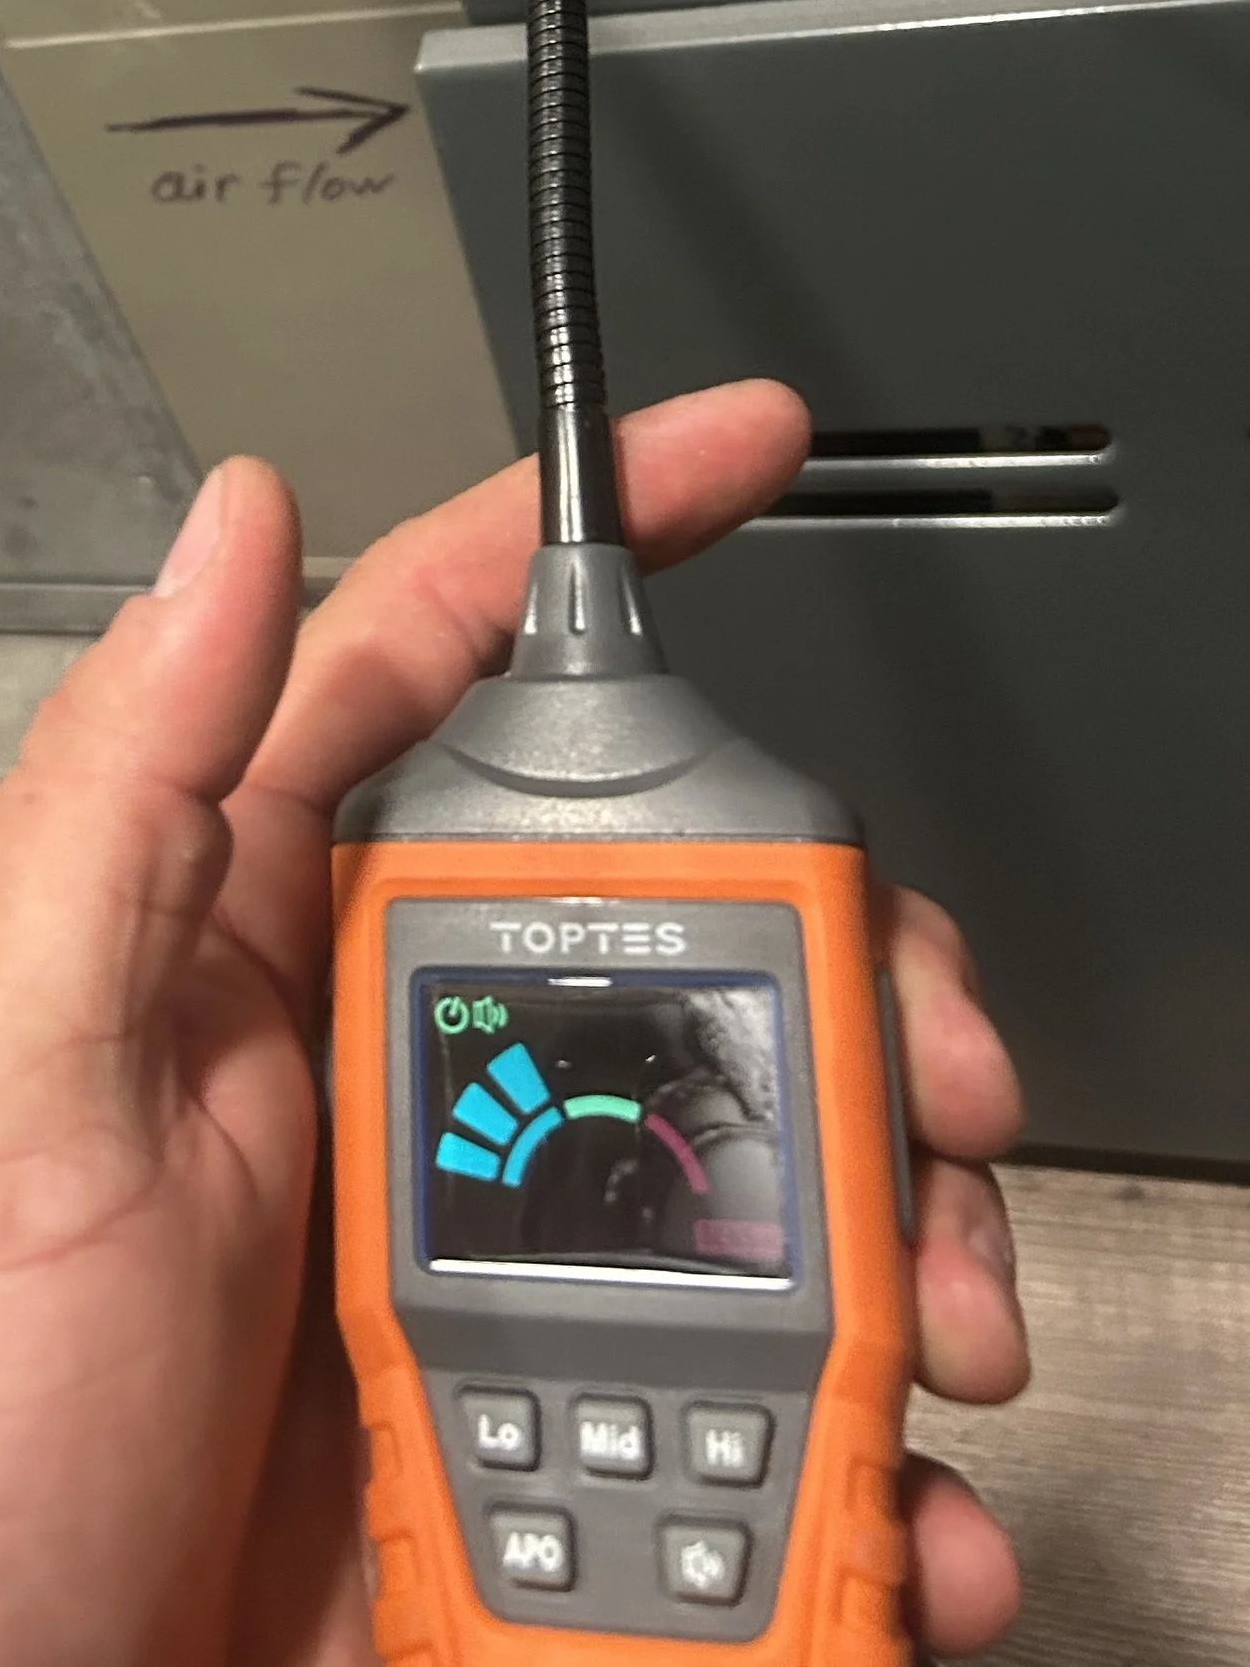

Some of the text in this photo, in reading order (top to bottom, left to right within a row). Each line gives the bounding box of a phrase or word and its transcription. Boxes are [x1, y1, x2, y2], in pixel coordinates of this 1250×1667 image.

[150, 159, 396, 207] air flow
[489, 920, 688, 957] TOPTES
[477, 1413, 746, 1468] Lo Mid Hi
